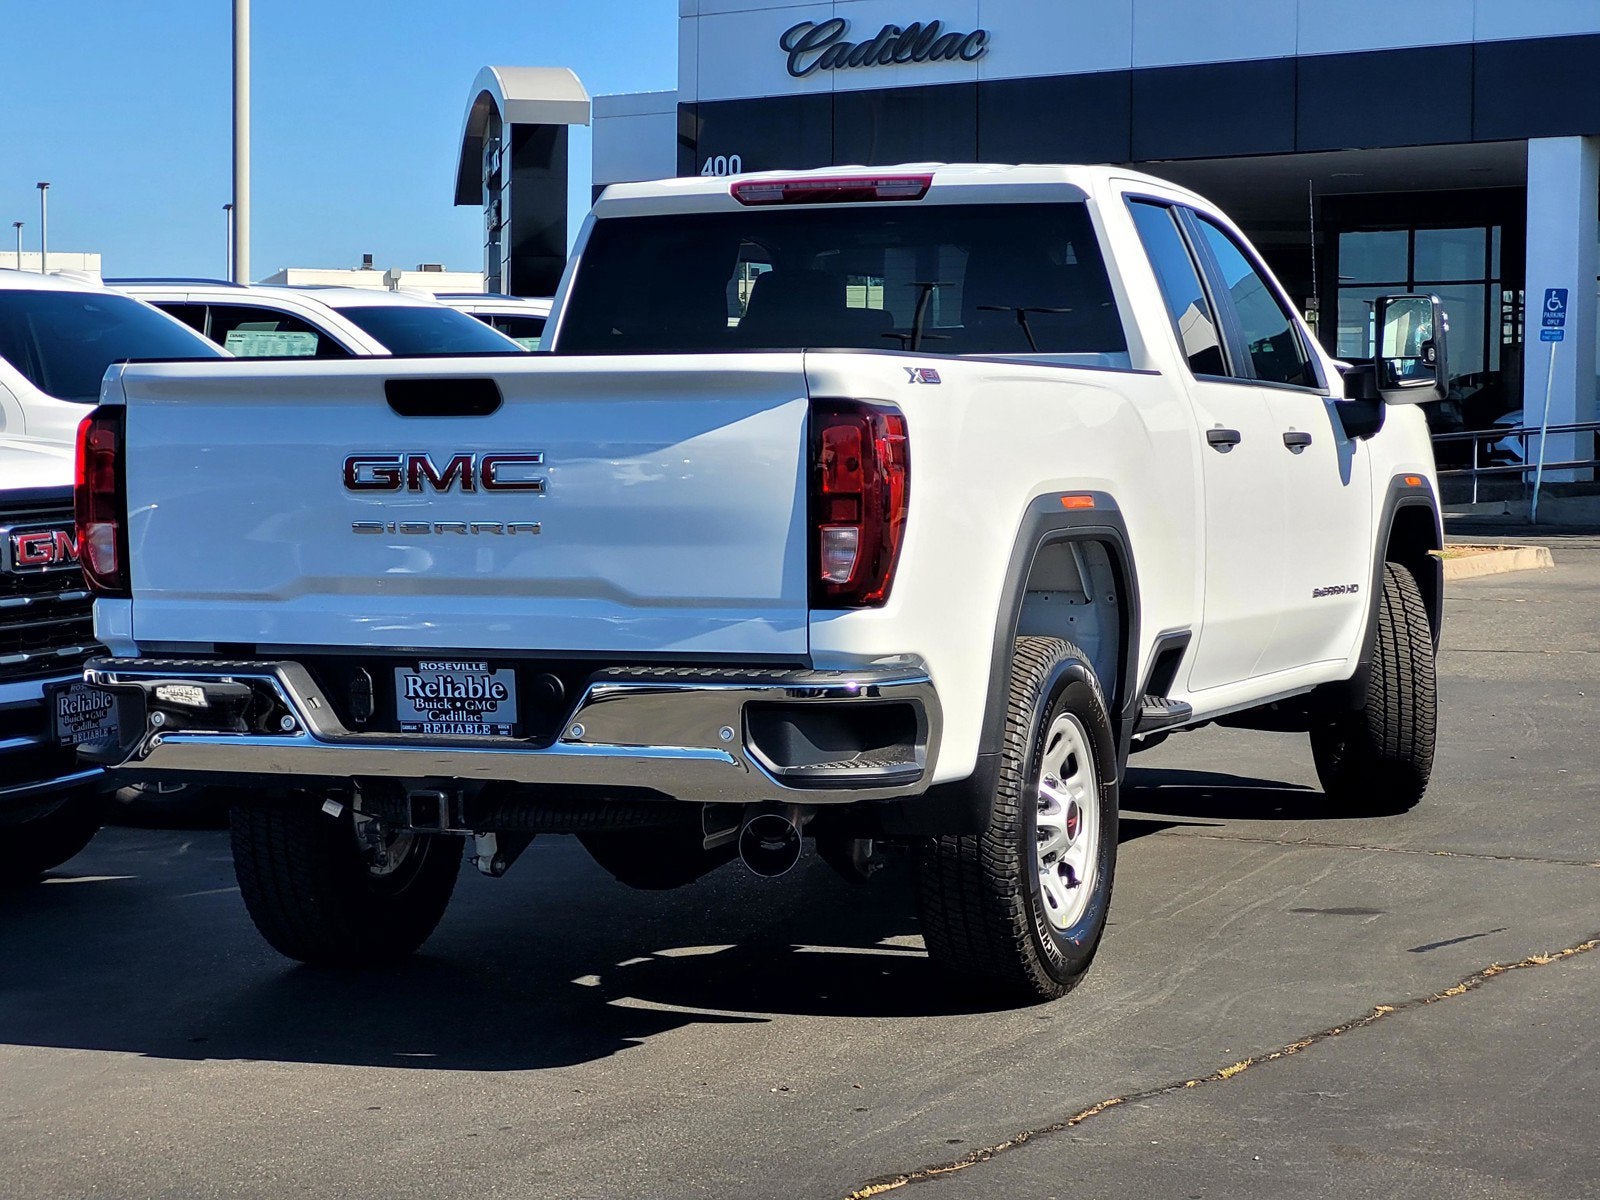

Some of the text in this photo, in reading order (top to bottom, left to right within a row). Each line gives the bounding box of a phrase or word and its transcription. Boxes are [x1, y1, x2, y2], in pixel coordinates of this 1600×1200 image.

[780, 17, 989, 78] Cadillac
[701, 154, 742, 177] 400
[343, 452, 544, 493] GMC
[352, 520, 541, 535] SIERRA
[16, 530, 79, 566] GM
[1345, 584, 1359, 594] HD
[420, 662, 487, 671] ROSEVILLE
[405, 675, 505, 699] Reliable
[60, 692, 111, 715] Reliable
[415, 698, 497, 711] Buick GMC
[64, 709, 107, 724] Buick GMC
[428, 710, 481, 722] Cadillac
[71, 721, 99, 733] Cadillac
[423, 723, 491, 735] RELIABLE
[72, 729, 108, 743] RELIABLE
[1032, 898, 1063, 968] MICHELIN
